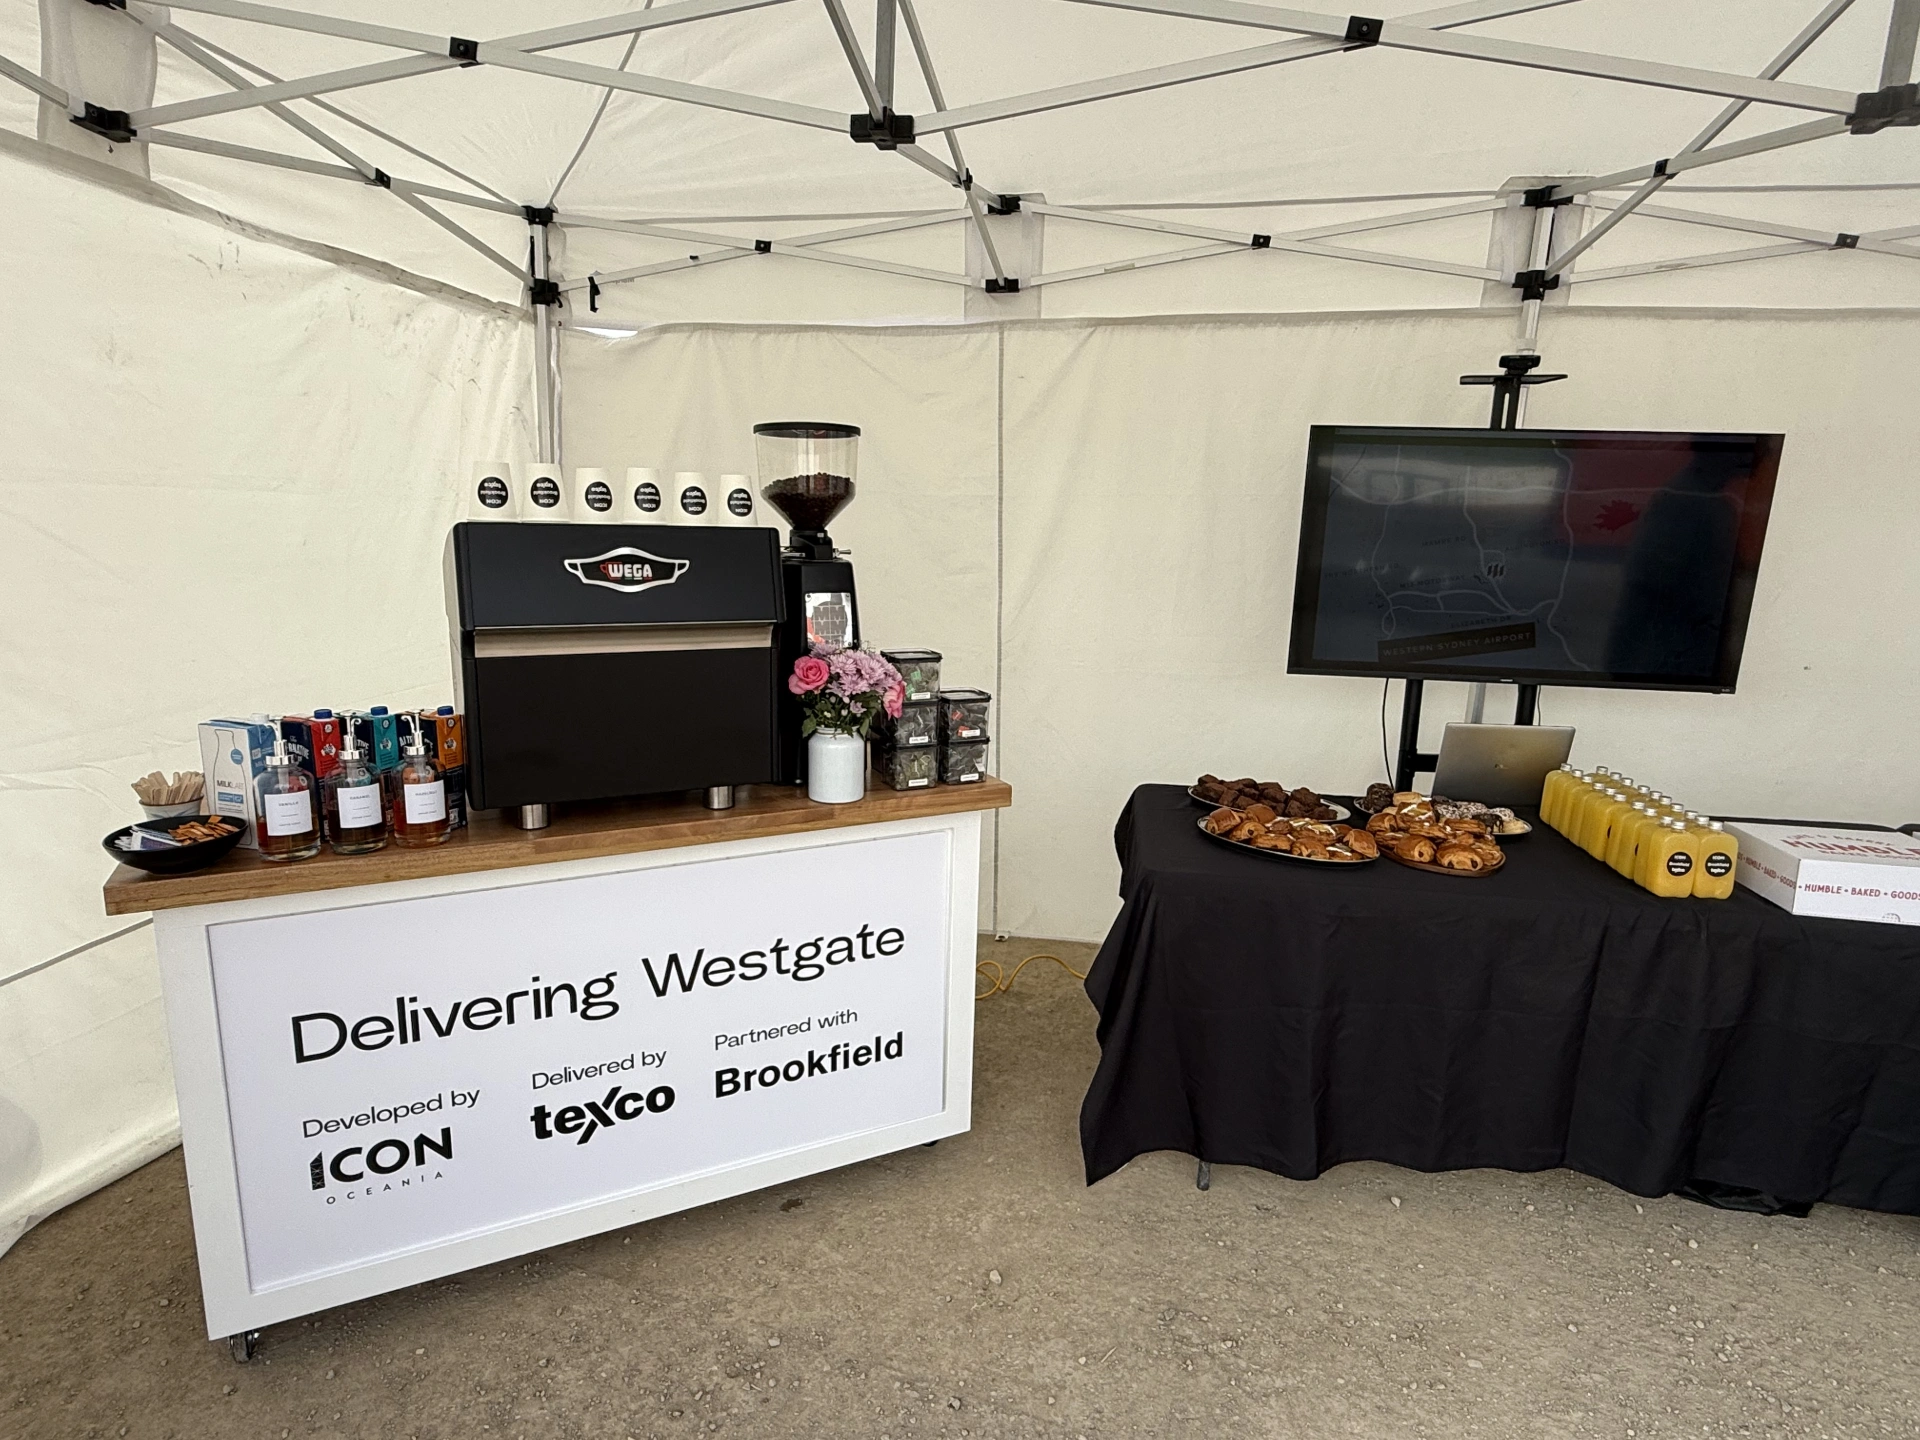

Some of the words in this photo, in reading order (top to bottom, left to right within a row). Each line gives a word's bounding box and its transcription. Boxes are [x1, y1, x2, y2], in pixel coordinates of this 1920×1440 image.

[608, 563, 653, 578] WEGA
[1382, 644, 1433, 656] WESTERN
[1437, 638, 1480, 650] SYDNEY
[1483, 632, 1531, 645] AIRPORT
[1804, 883, 1842, 894] HUMBLE
[1850, 887, 1881, 897] BAKED
[292, 972, 620, 1063] Delivering
[642, 924, 905, 998] Westgate
[715, 1017, 811, 1051] Partnered
[817, 1008, 858, 1029] with
[532, 1054, 635, 1090] Delivered
[641, 1048, 668, 1070] by
[715, 1032, 905, 1098] Brookfield
[302, 1093, 443, 1139] Developed
[450, 1087, 481, 1110] by
[530, 1085, 677, 1145] texco
[309, 1127, 454, 1191] ICON
[326, 1170, 445, 1205] OCEANIA
